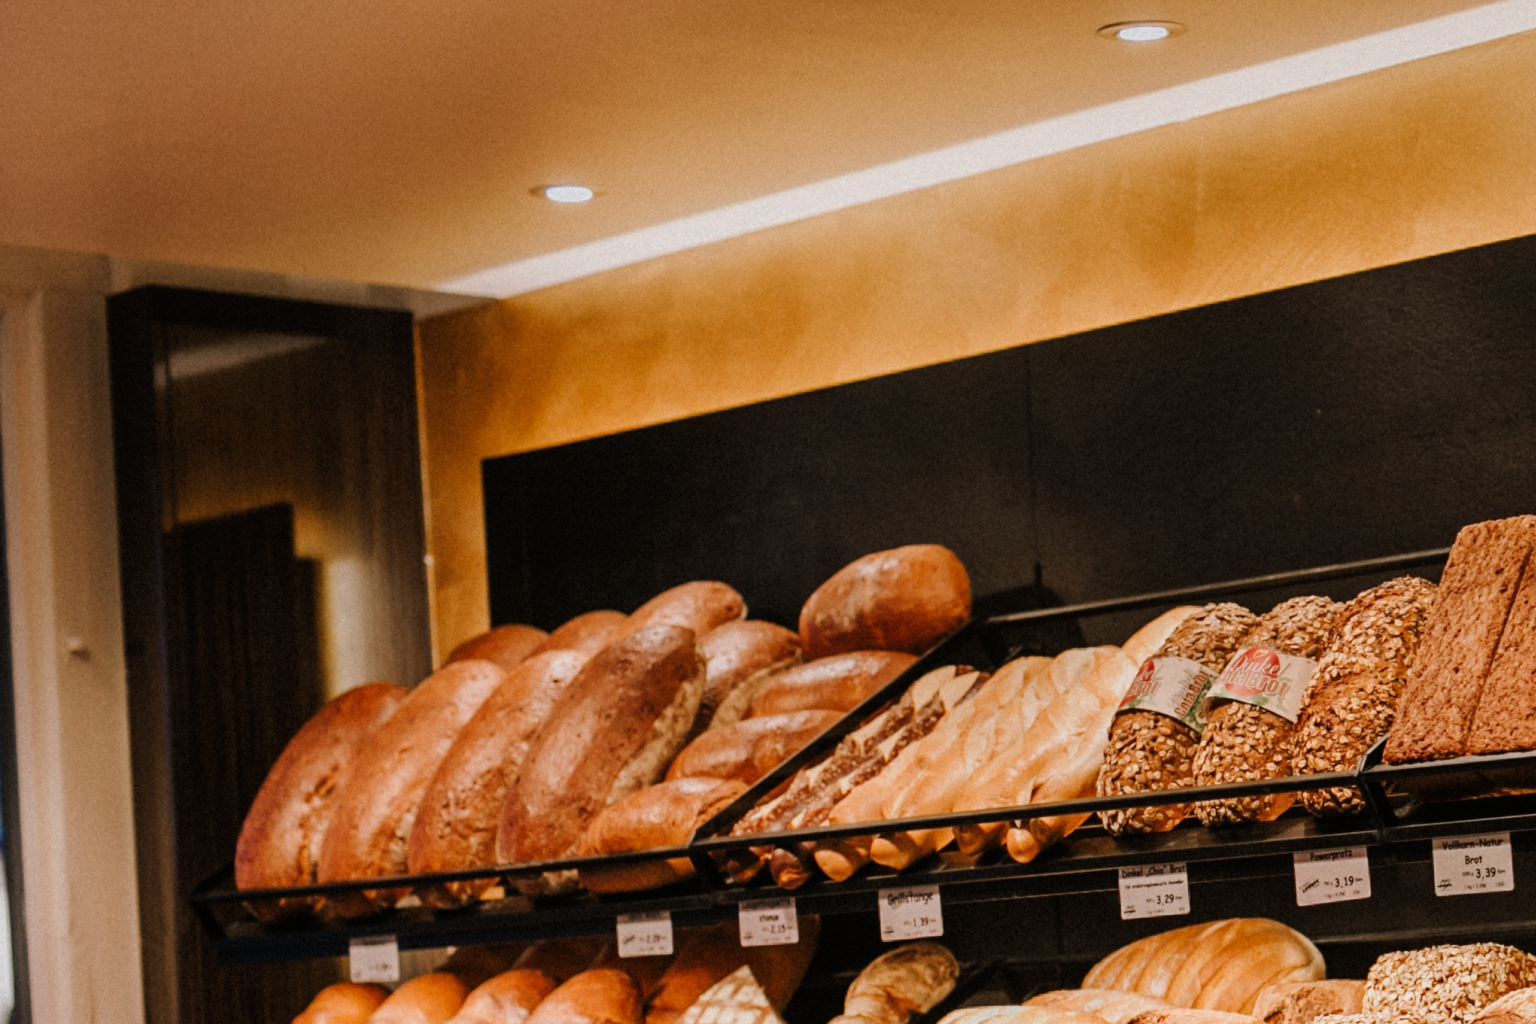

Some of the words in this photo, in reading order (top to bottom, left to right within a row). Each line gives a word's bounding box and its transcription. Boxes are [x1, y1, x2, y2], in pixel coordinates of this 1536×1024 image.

[1442, 839, 1504, 850] Vollkorn-Natur
[1310, 849, 1353, 861] Powerprotz
[1465, 855, 1483, 865] Brot
[1122, 867, 1143, 878] Dinkel
[1170, 863, 1186, 874] Brot
[1475, 867, 1496, 880] 3,39
[1334, 876, 1354, 888] 3,19
[887, 891, 934, 906] Grillstange
[1156, 894, 1175, 906] 3,29
